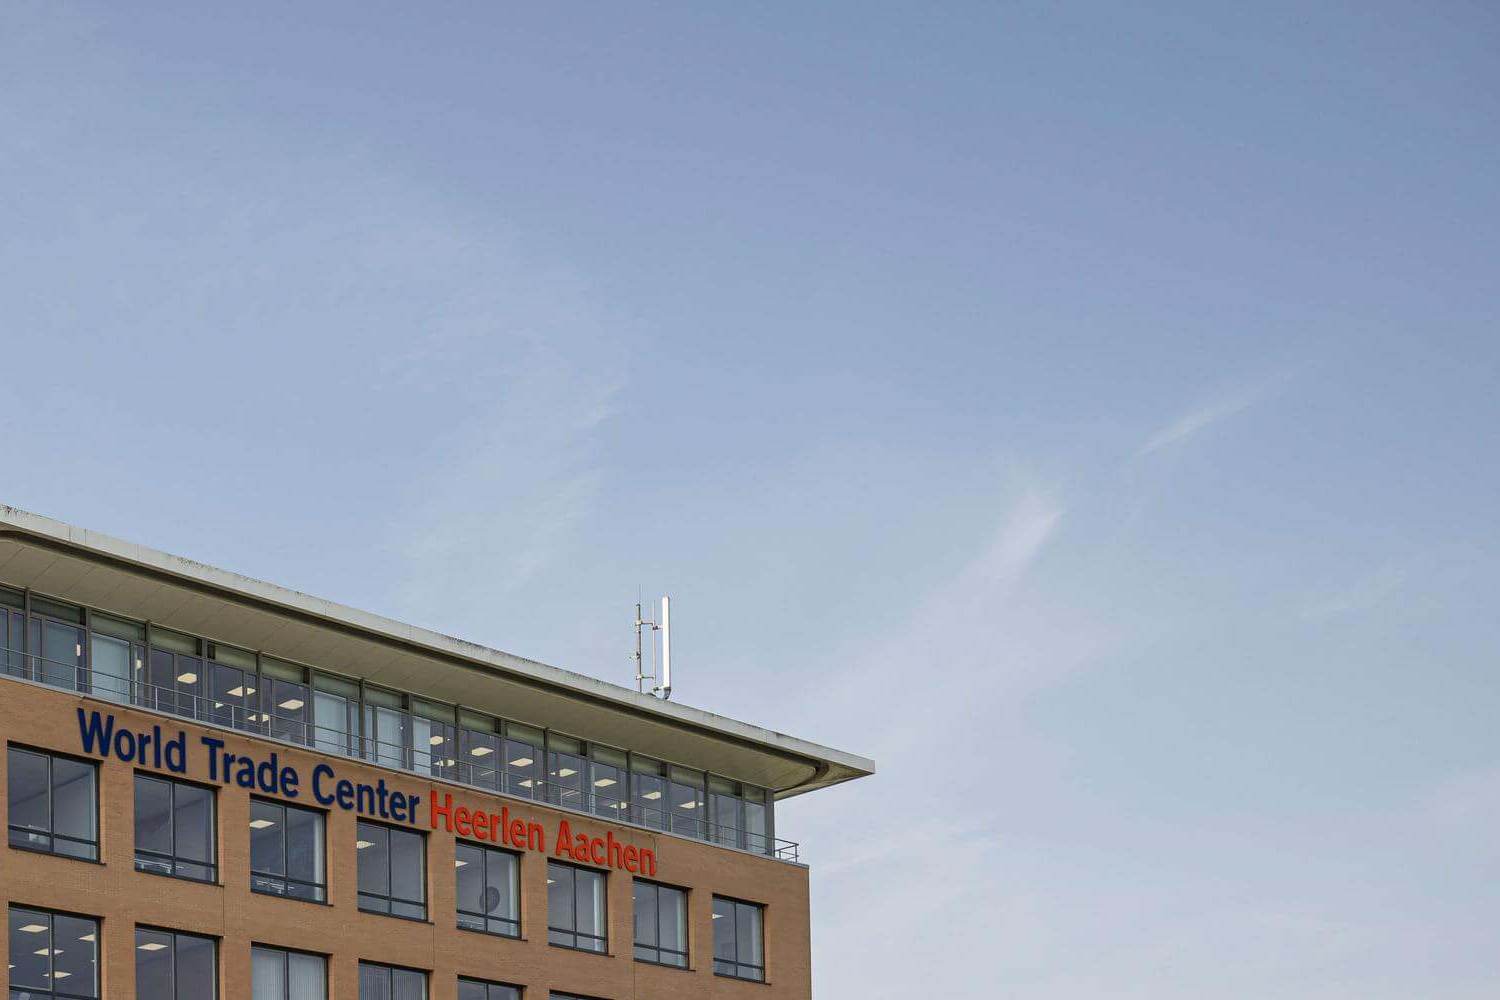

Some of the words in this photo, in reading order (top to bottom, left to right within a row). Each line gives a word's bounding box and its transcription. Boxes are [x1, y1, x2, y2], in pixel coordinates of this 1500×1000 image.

[77, 707, 186, 773] World
[201, 735, 299, 799] Trade
[312, 763, 420, 824] Center
[430, 790, 546, 853] Heerlen
[555, 819, 657, 877] Aachen
